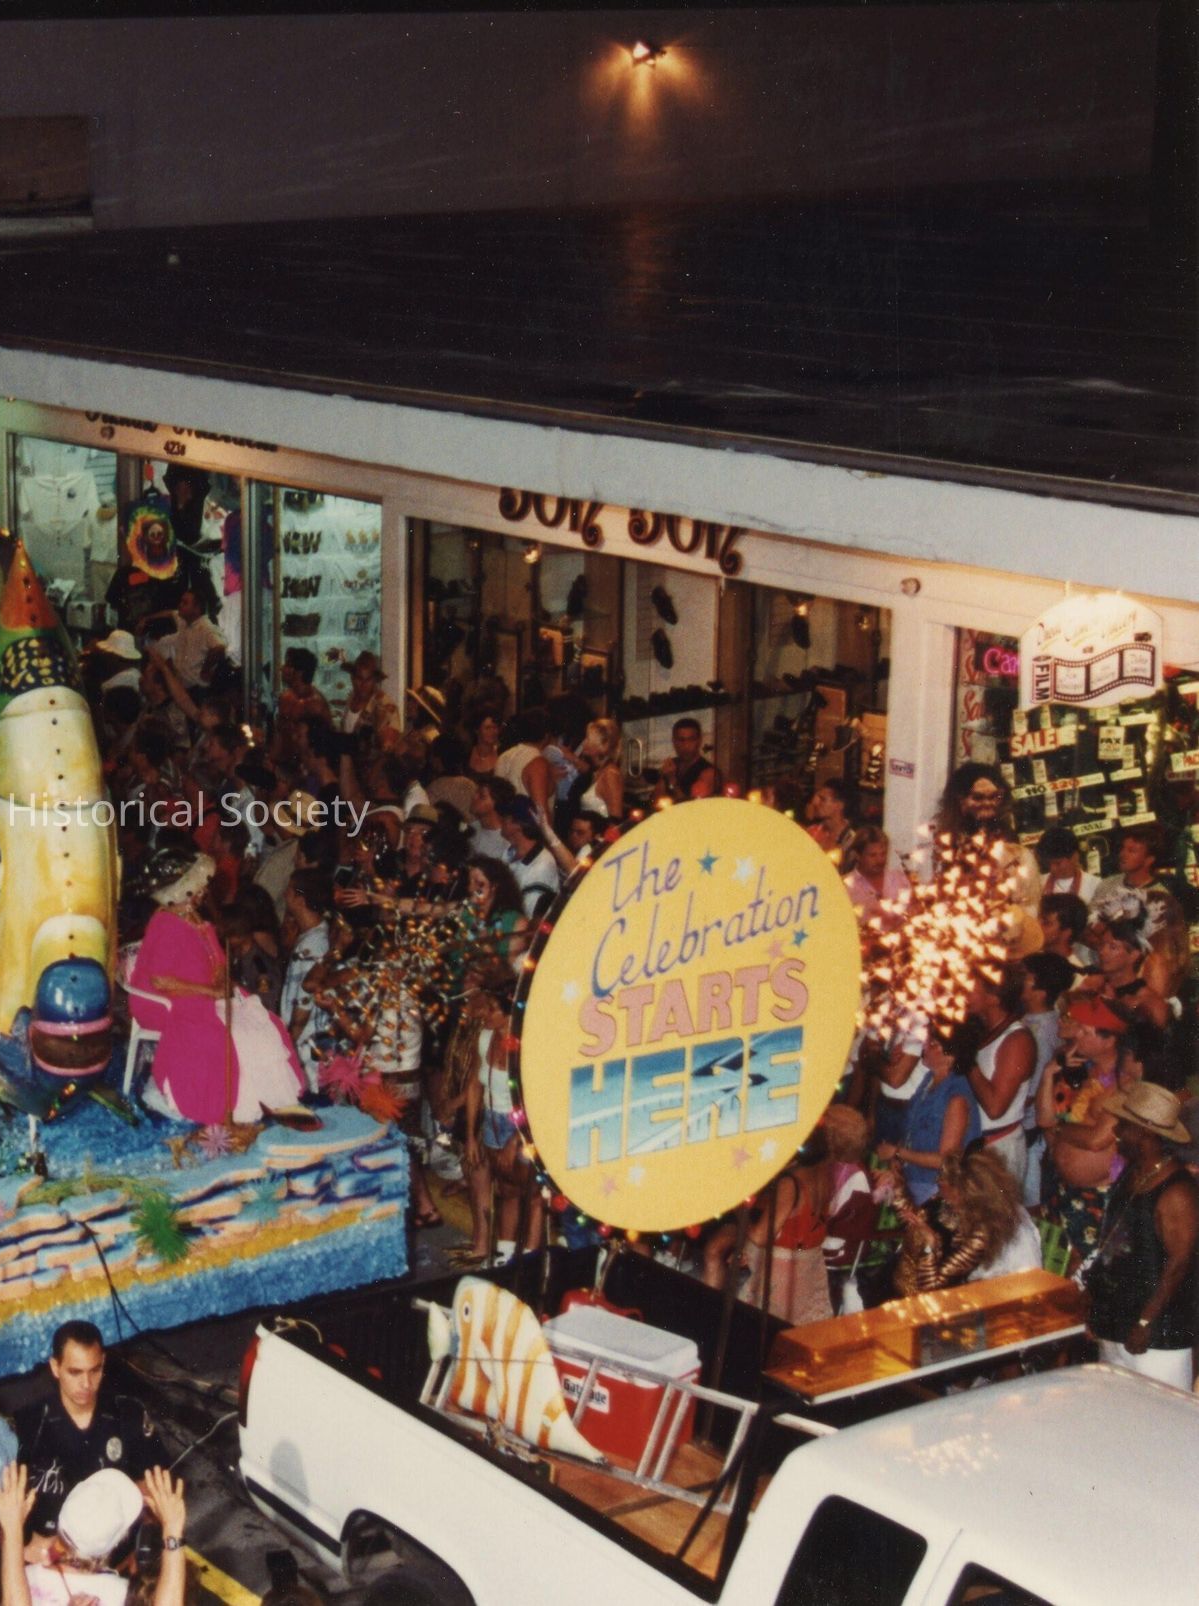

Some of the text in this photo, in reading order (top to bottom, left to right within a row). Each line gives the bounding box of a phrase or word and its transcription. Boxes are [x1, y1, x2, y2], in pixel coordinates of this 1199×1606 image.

[1035, 664, 1050, 701] FILM
[1010, 728, 1059, 758] SALE
[603, 840, 683, 913] The
[590, 866, 820, 998] Celebration
[578, 957, 810, 1059] STARTS
[566, 1026, 805, 1171] HERE
